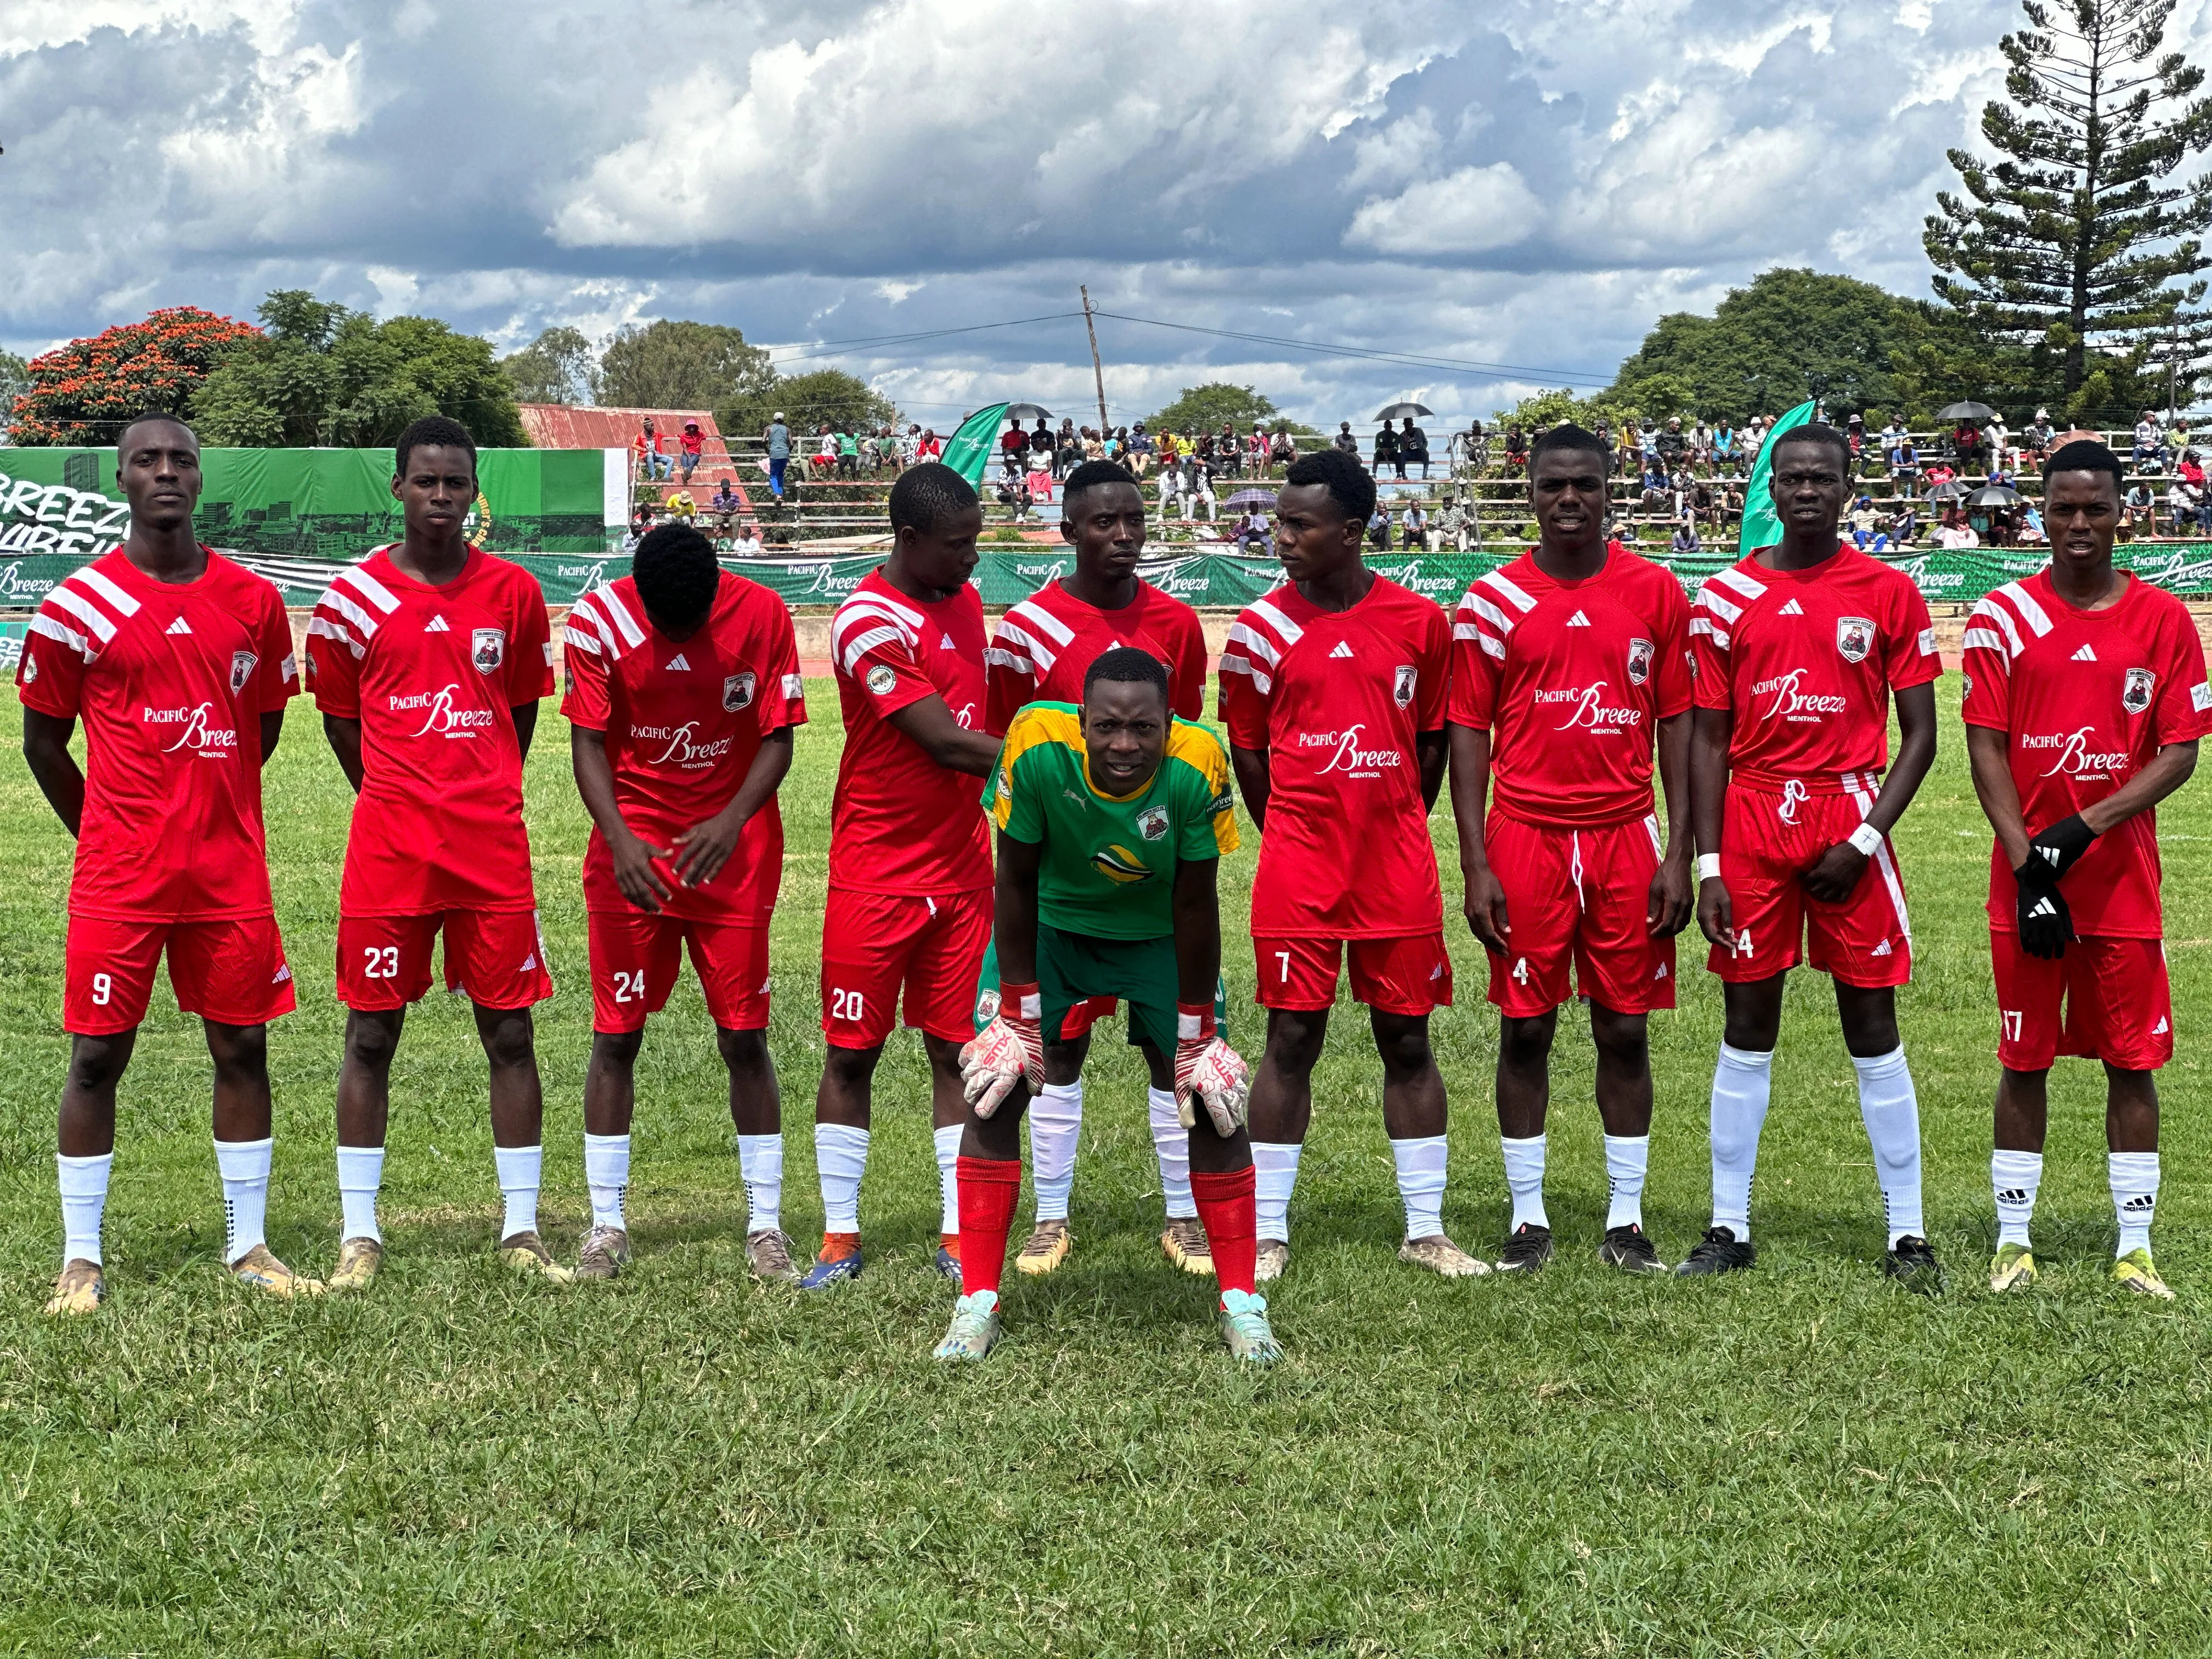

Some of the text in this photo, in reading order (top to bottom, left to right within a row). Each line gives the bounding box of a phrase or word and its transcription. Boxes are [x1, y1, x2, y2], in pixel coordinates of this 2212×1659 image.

[0, 473, 131, 540] REEZ
[0, 561, 54, 594] Breeze
[558, 565, 589, 576] PACIFIC
[788, 565, 817, 575] PACIFIC
[1017, 564, 1047, 575] PACIFIC
[1156, 562, 1210, 593] Breeze
[1400, 560, 1457, 591] Breeze
[1909, 556, 1964, 588] Breeze
[2004, 560, 2039, 569] PACIFIC
[2133, 550, 2212, 584] PACIFIC Breez
[1534, 688, 1579, 703] PACIFIC
[1751, 668, 1846, 720] ACIFIC Breeze
[144, 707, 188, 723] PACIFIC
[390, 684, 493, 737] PACIFIC Breeze
[631, 724, 670, 740] PACIFIC
[2022, 733, 2064, 748] PACIFIC
[198, 750, 228, 758] MENTHOL
[1299, 724, 1401, 774] PACIFIC Breeze
[682, 761, 715, 769] MENTHOL
[364, 947, 398, 978] 23
[1275, 951, 1290, 983] 7
[1513, 957, 1528, 986] 4
[92, 973, 111, 1005] 9
[613, 969, 645, 1003] 24
[832, 988, 864, 1022] 20
[2003, 1010, 2022, 1042] 17
[1996, 1195, 2029, 1205] adidas
